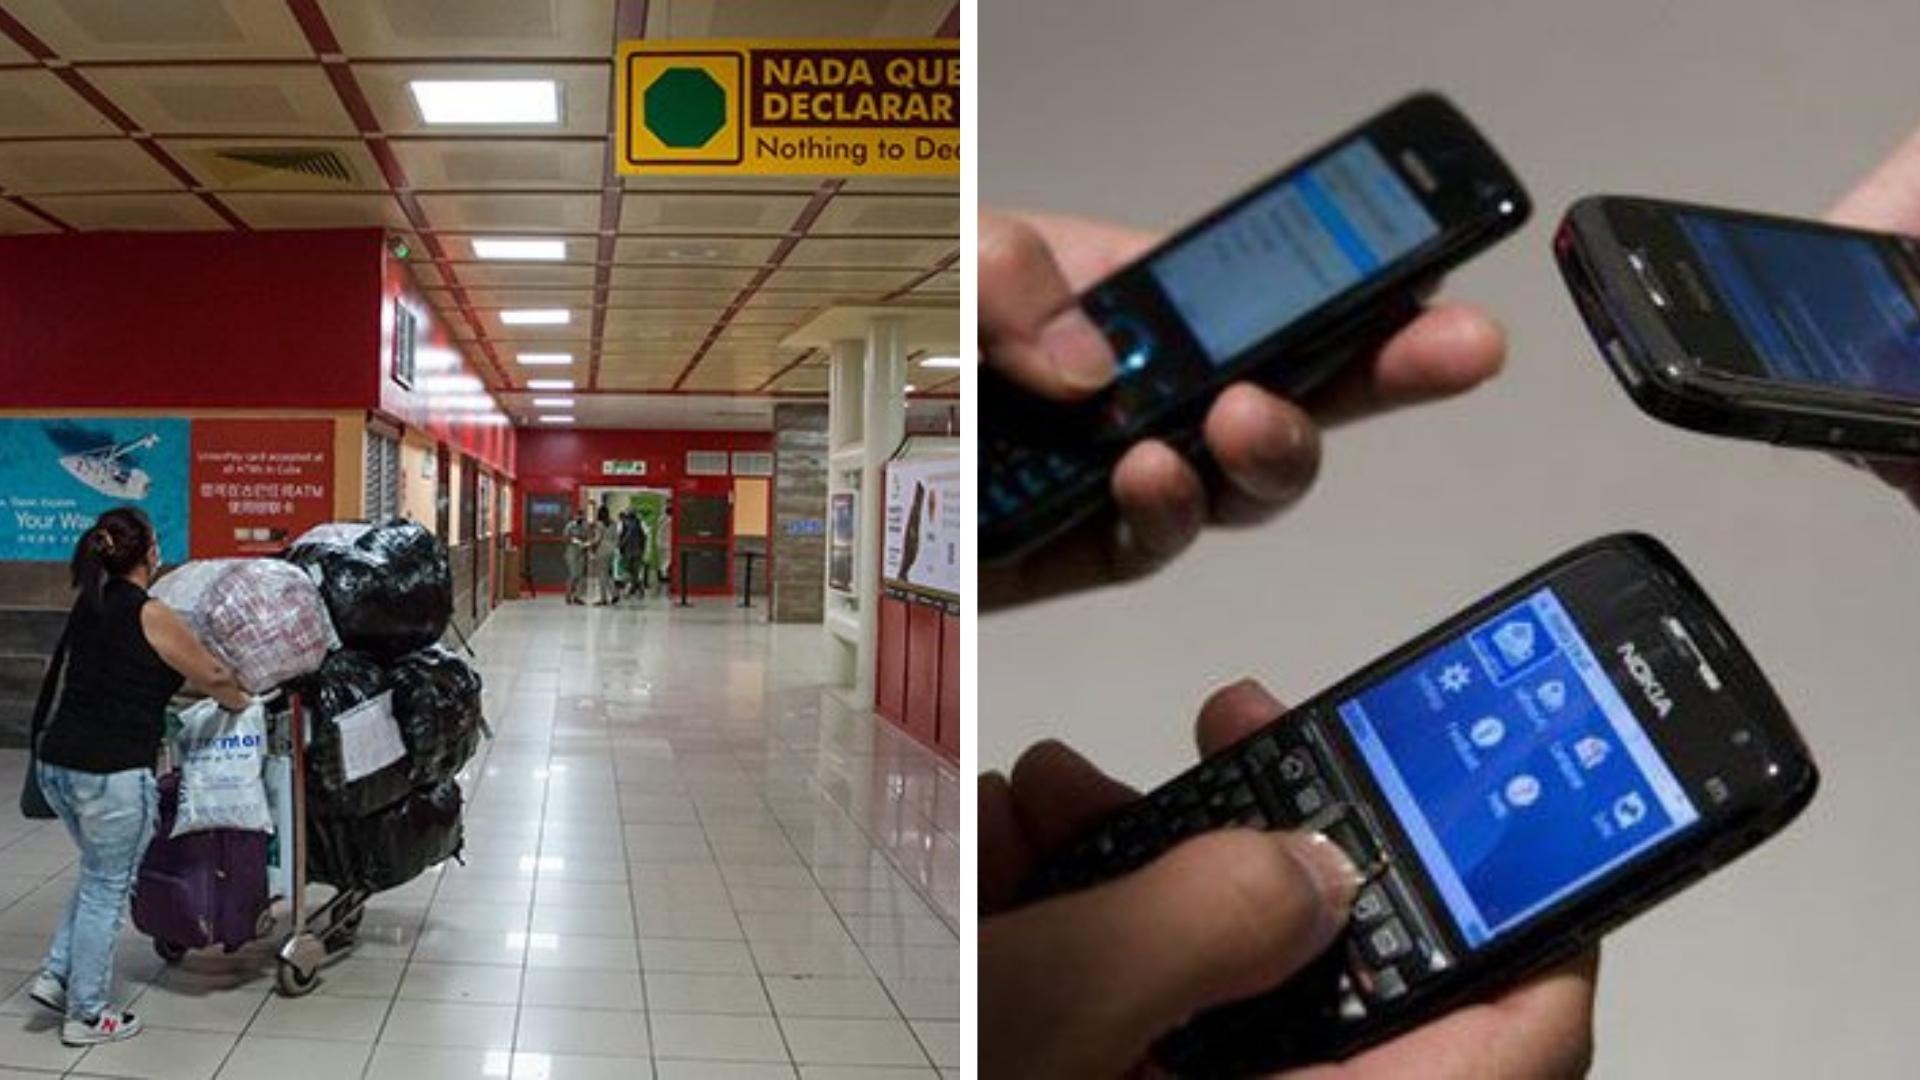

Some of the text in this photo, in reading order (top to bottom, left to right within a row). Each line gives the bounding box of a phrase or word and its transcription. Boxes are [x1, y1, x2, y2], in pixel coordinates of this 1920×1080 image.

[763, 58, 960, 88] NADA QUE
[763, 91, 953, 121] DECLARAR
[756, 136, 867, 166] Nothing
[878, 138, 905, 160] to
[14, 510, 56, 530] Your
[1617, 642, 1673, 717] NOKIA
